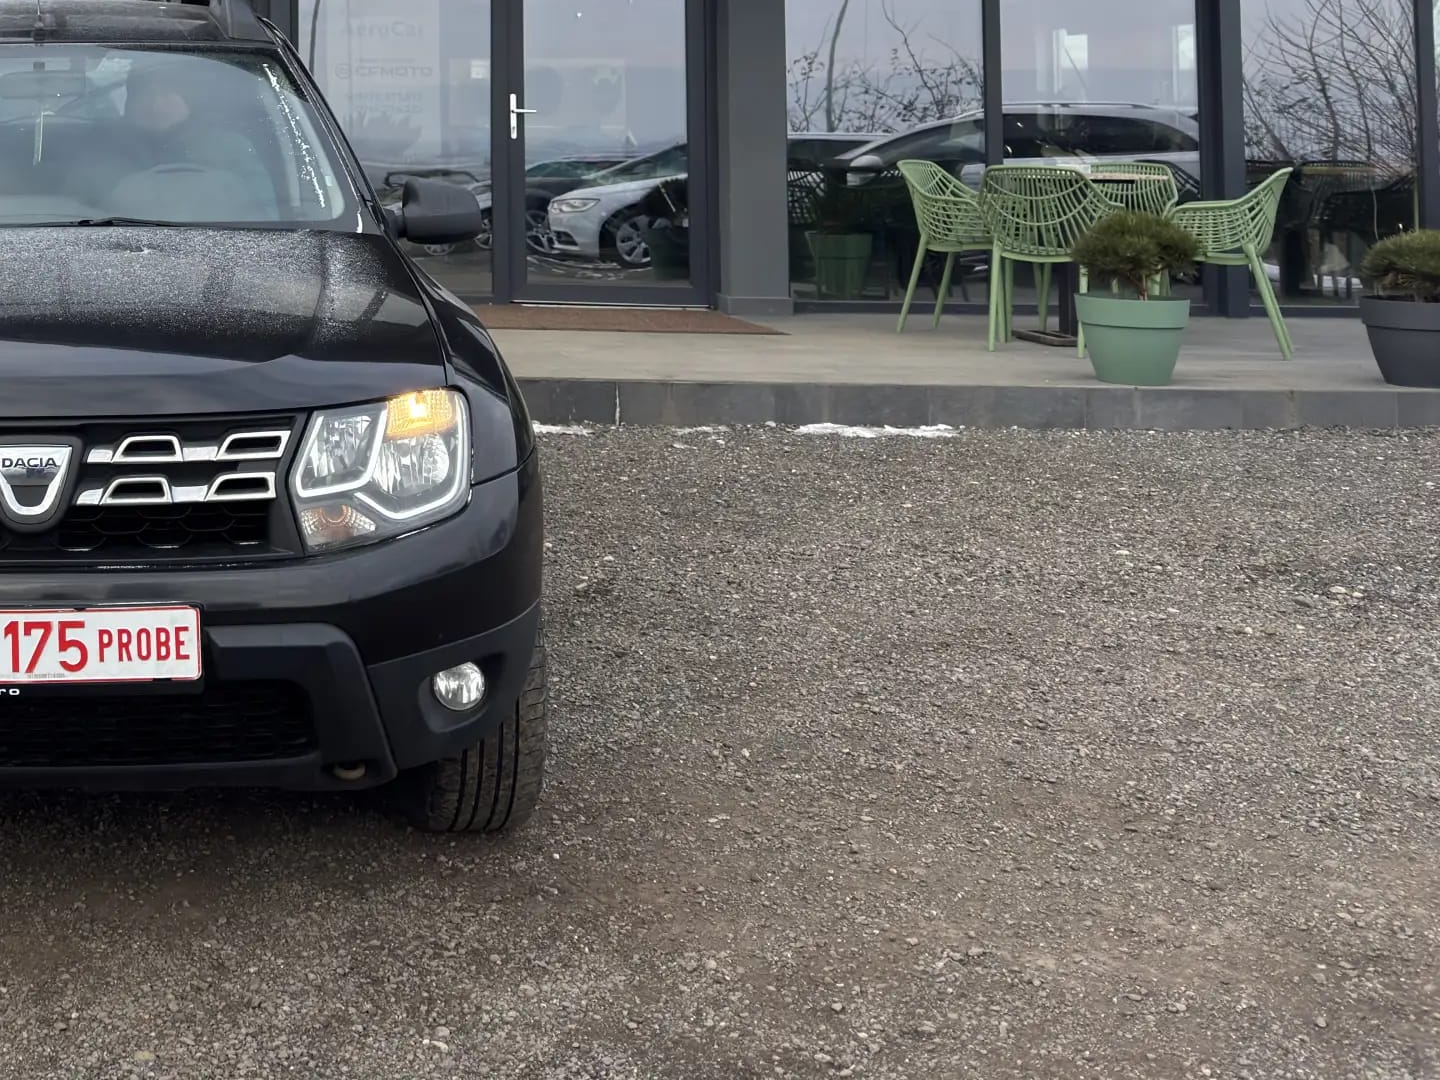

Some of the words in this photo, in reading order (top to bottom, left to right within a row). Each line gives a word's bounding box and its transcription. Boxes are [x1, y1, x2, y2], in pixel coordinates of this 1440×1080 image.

[1, 457, 58, 468] DACIA
[4, 620, 89, 673] 175
[98, 626, 190, 662] PROBE
